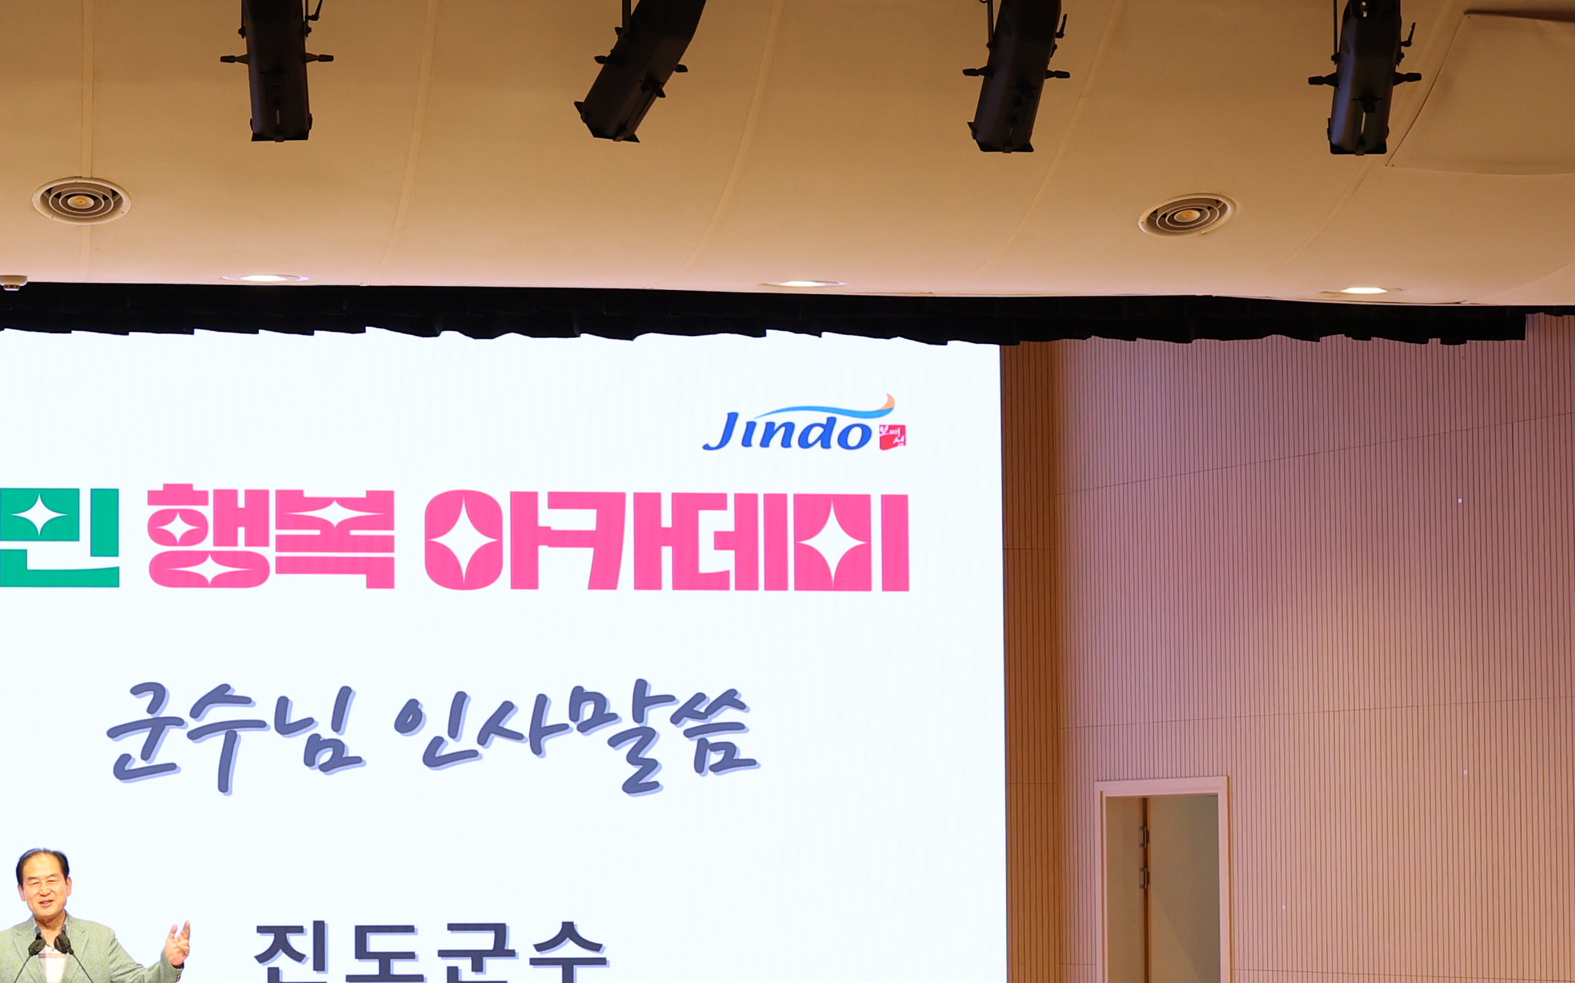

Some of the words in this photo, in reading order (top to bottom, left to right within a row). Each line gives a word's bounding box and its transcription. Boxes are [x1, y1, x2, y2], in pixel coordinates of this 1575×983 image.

[702, 411, 872, 451] Jindo
[148, 483, 395, 589] 행복
[425, 489, 909, 592] 아카데미
[106, 682, 365, 795] 군수님
[394, 678, 760, 796] 인사말씀
